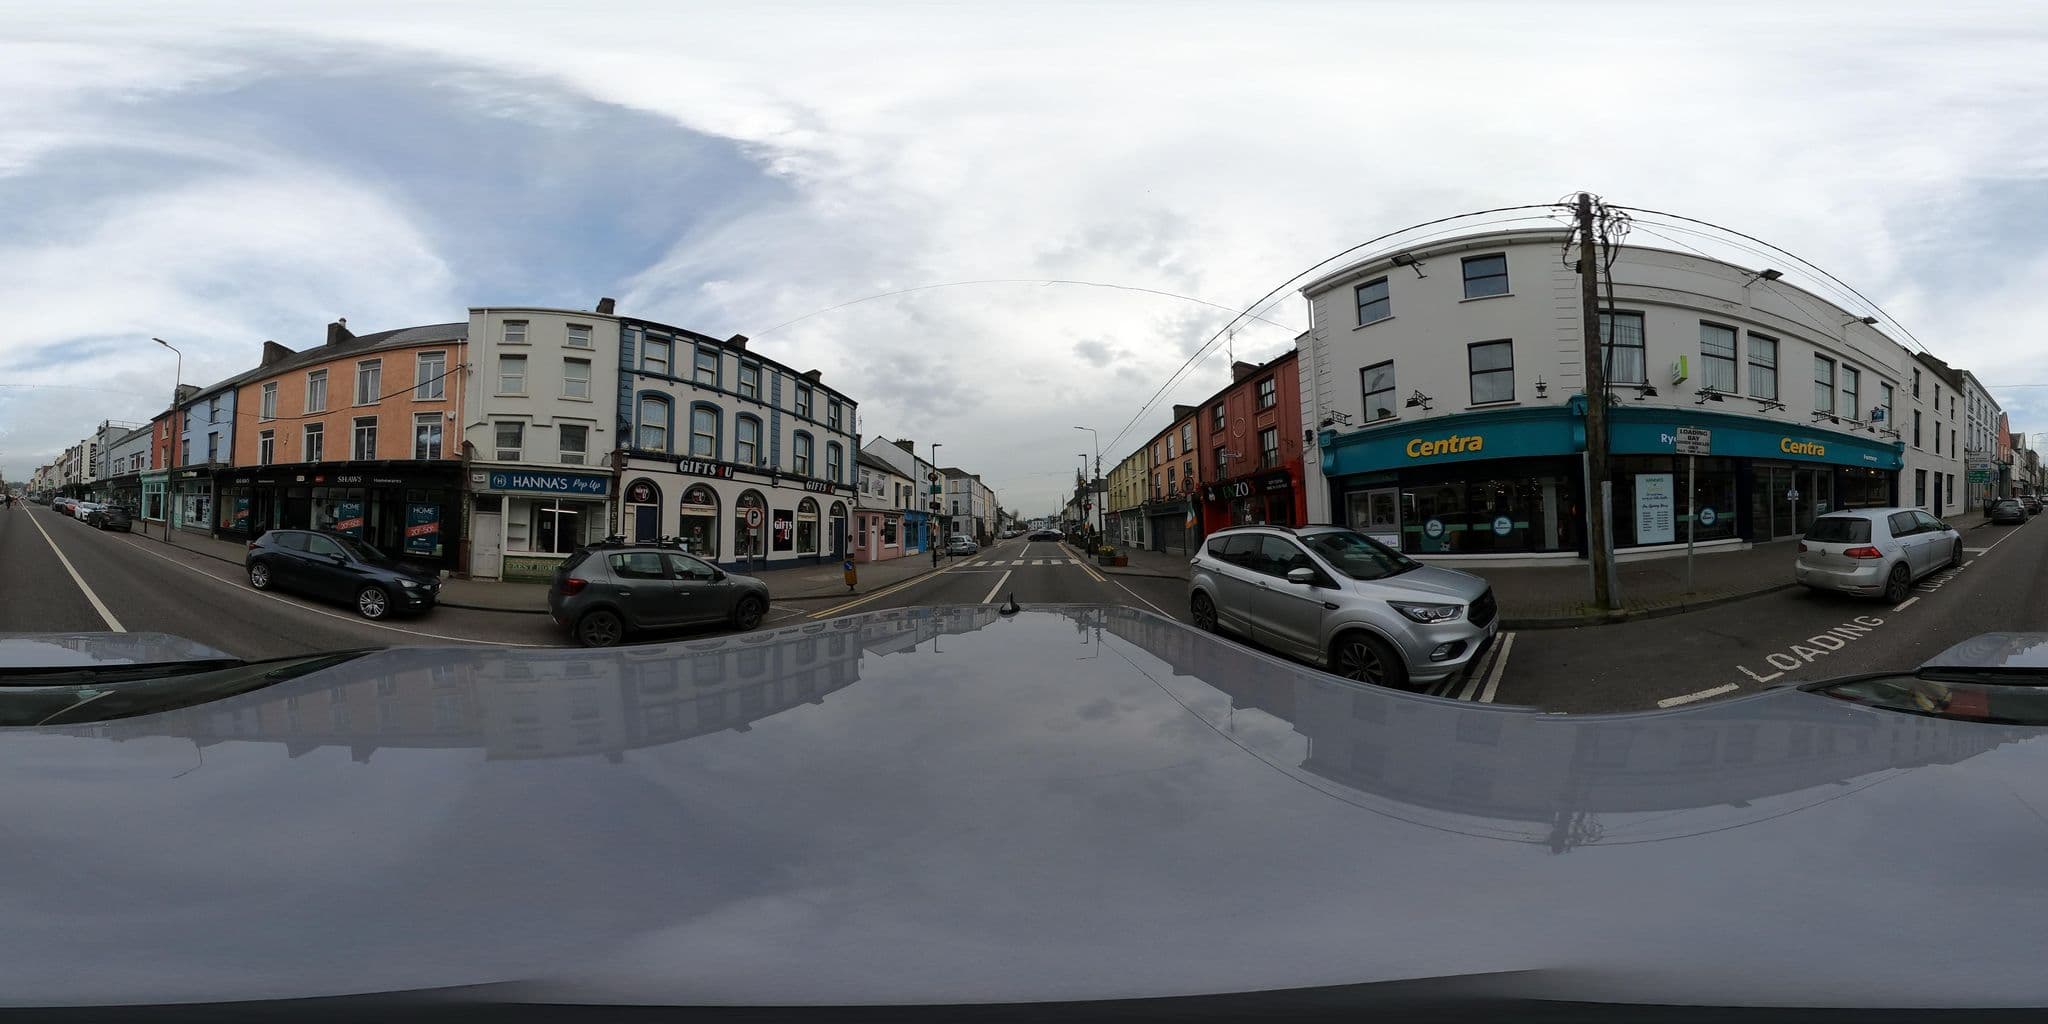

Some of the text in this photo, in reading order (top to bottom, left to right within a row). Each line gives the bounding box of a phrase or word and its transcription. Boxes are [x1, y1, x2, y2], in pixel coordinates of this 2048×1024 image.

[1407, 435, 1483, 457] Centra
[1781, 437, 1825, 456] Centra
[513, 475, 568, 490] HANNA'S
[412, 507, 437, 515] HOME
[1736, 615, 1885, 683] LOADING
